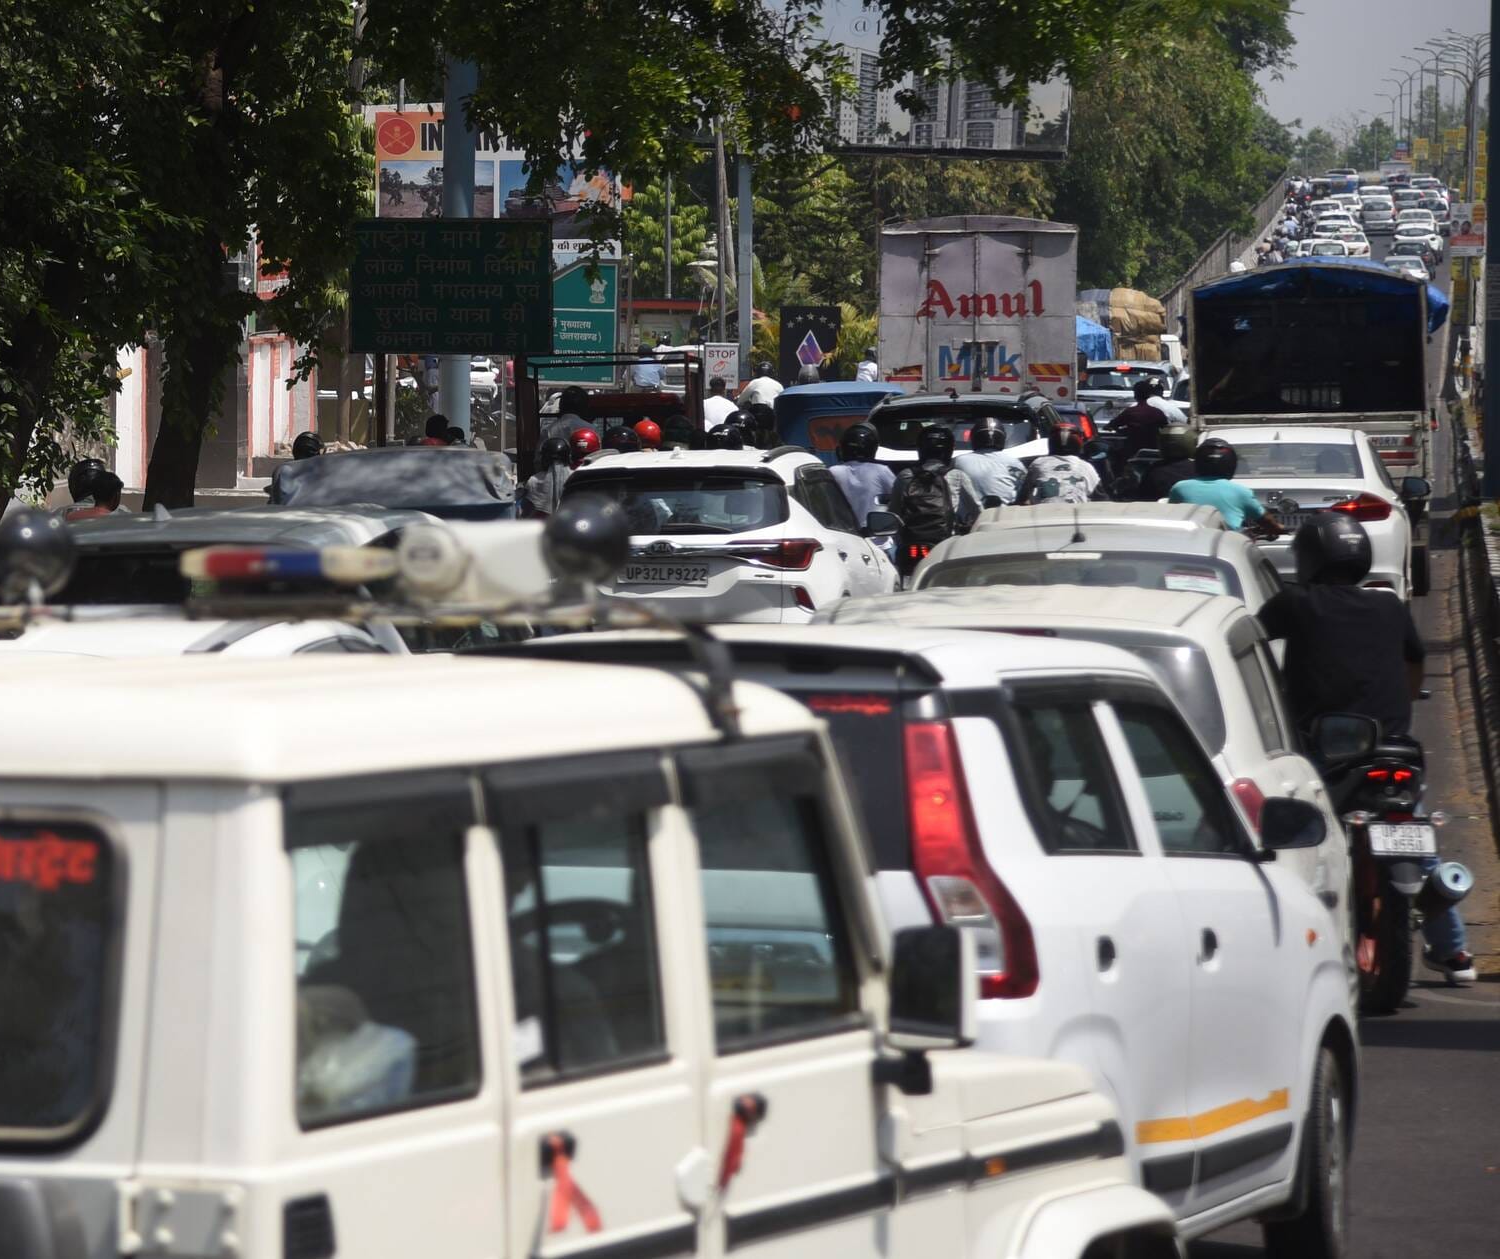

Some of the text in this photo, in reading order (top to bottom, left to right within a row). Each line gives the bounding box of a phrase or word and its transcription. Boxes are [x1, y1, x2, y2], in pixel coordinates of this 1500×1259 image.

[357, 224, 427, 253] राष्ट्रीय
[440, 225, 481, 249] मार्ग
[364, 254, 537, 275] लोक निर्माण विभाग
[360, 278, 541, 302] आपकी मंगलमय एवं
[916, 280, 1046, 325] Amul
[373, 303, 525, 329] सुरक्षित यात्रा की
[374, 331, 433, 347] कामना
[443, 331, 492, 347] करता
[708, 350, 736, 359] STOP
[939, 345, 1022, 378] Milk
[626, 563, 707, 583] UP32LP9222
